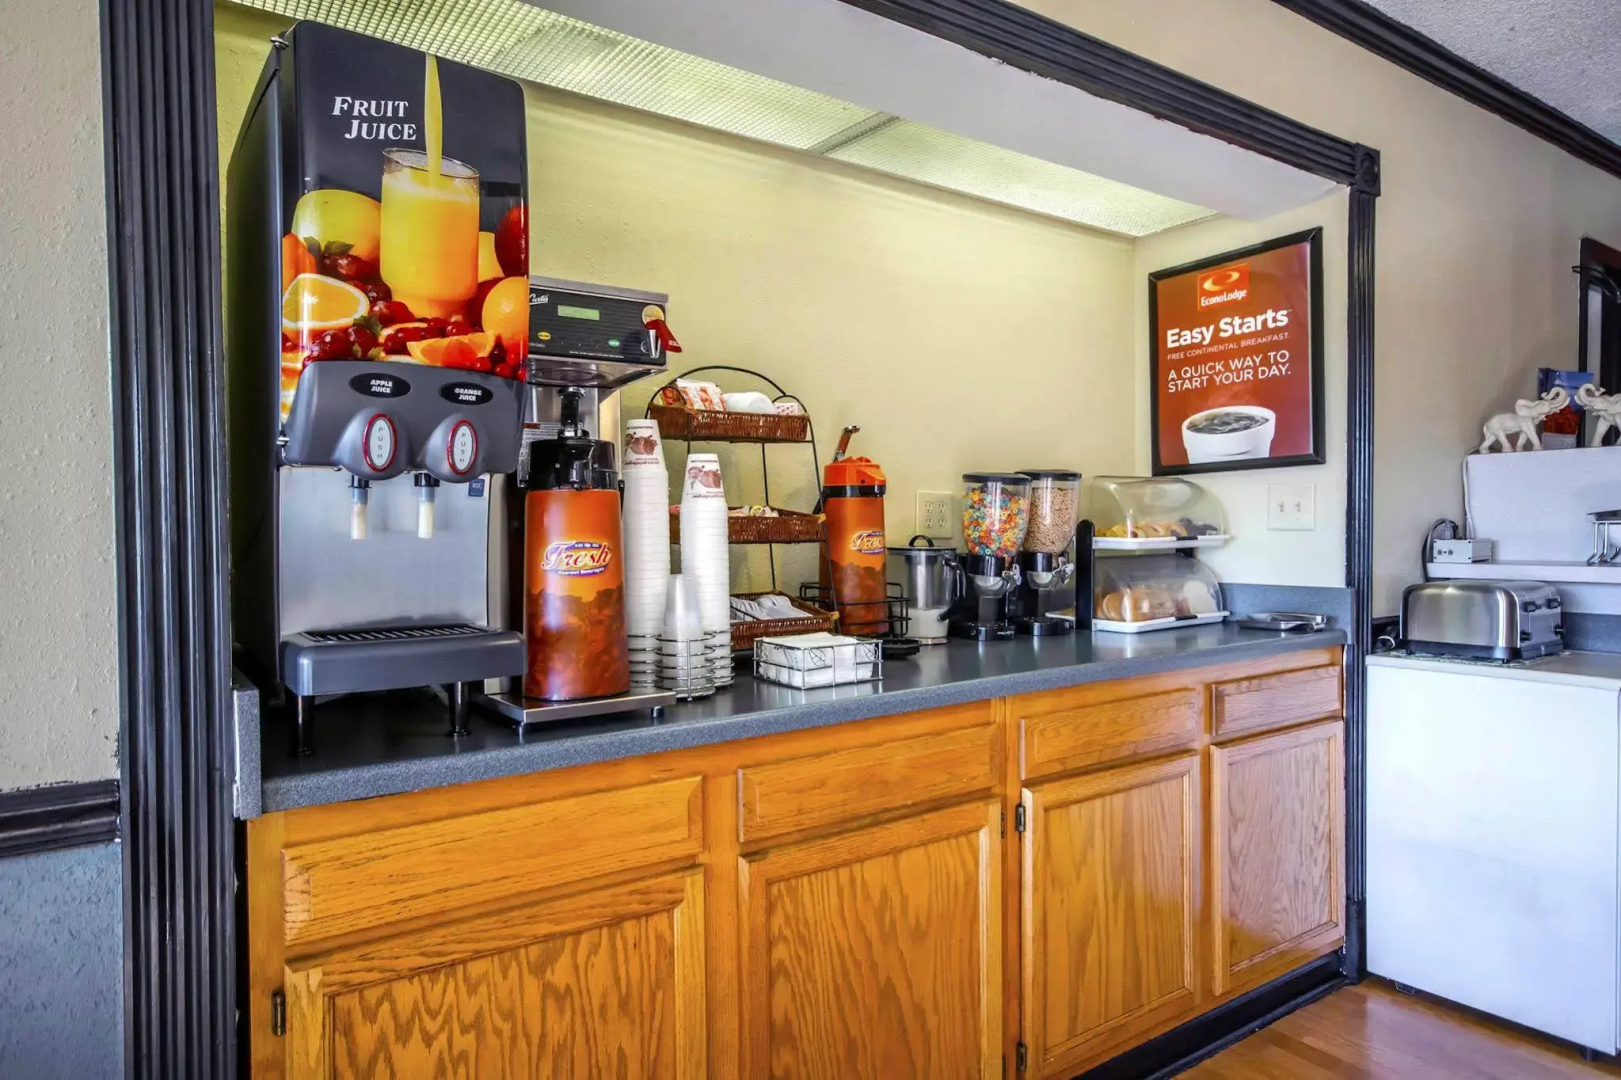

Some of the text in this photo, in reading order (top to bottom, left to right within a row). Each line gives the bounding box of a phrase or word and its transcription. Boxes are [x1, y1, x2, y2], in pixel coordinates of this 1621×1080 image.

[331, 96, 409, 117] FRUIT
[344, 119, 417, 140] JUICE
[1166, 308, 1290, 348] Easy Starts
[1167, 332, 1291, 361] FREE CONTINENTAL BREAKFAST.
[1168, 350, 1290, 381] A QUICK WAY TO
[1168, 363, 1292, 393] START YOUR DAY.
[370, 379, 393, 388] APPLE
[371, 386, 391, 394] JUICE
[454, 387, 482, 396] ORANGE
[458, 394, 477, 402] JUICE
[459, 432, 467, 463] PUSH
[541, 541, 611, 570] Fresh
